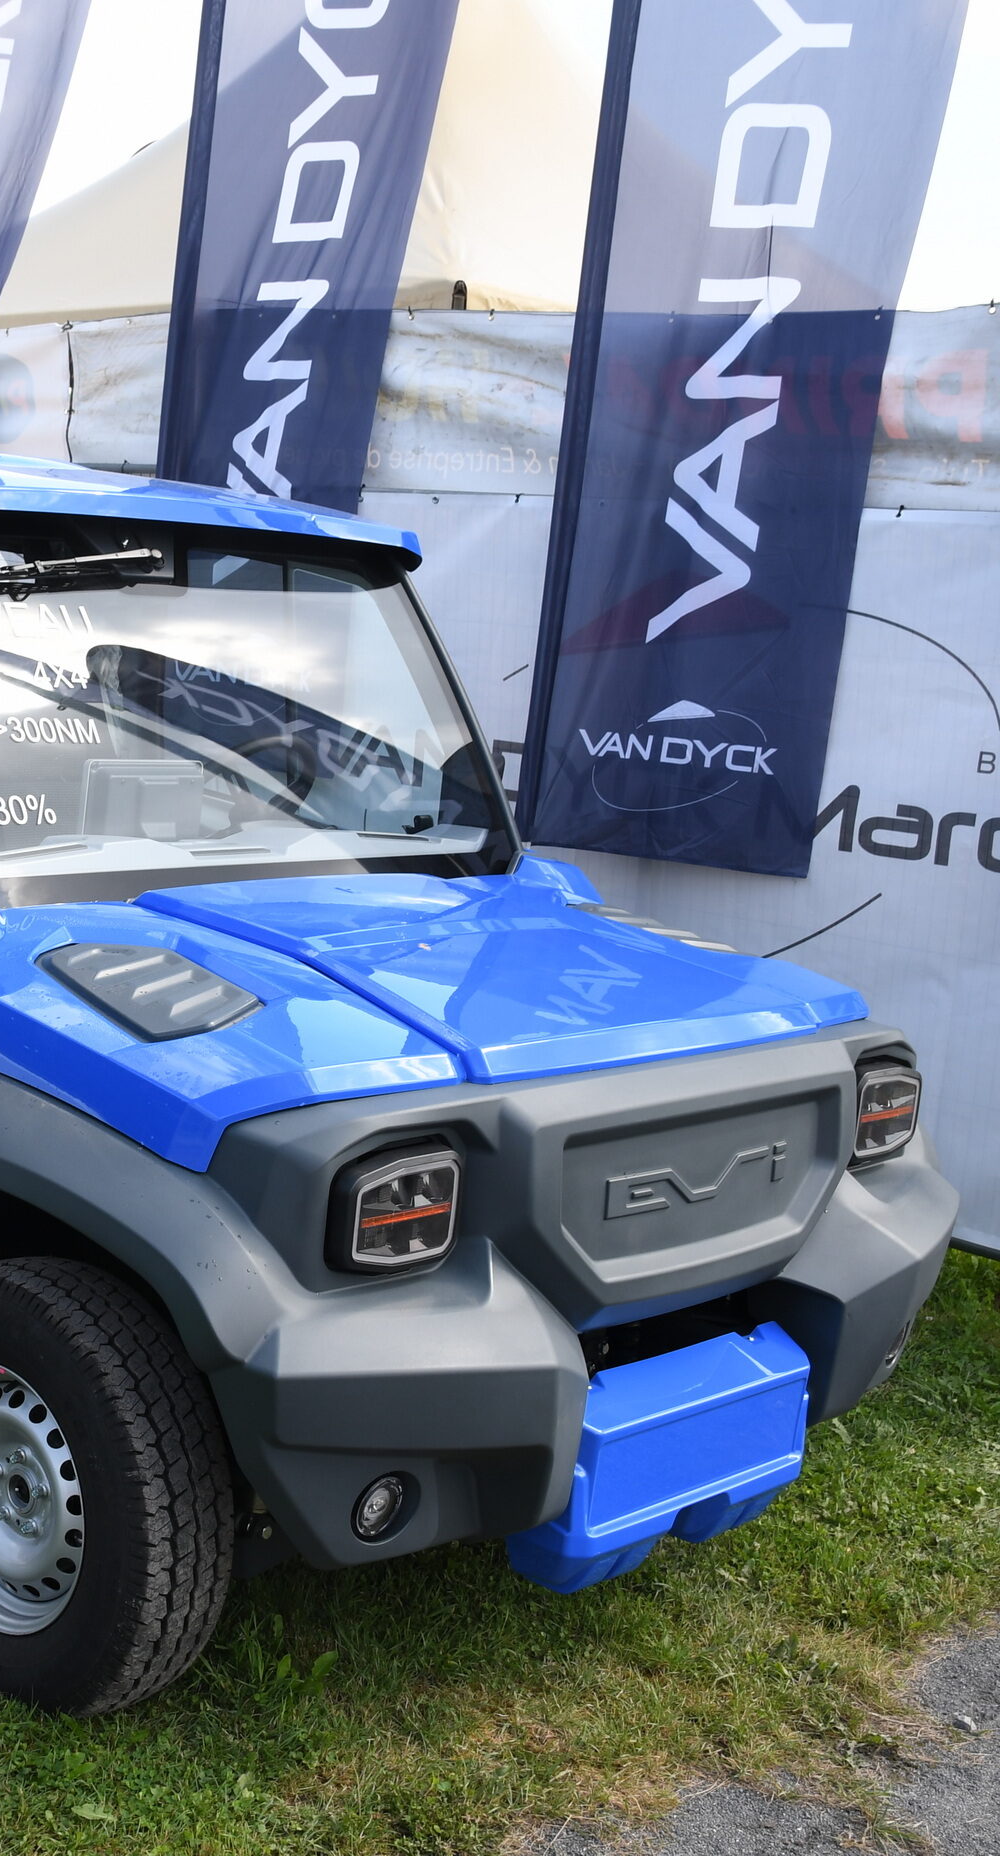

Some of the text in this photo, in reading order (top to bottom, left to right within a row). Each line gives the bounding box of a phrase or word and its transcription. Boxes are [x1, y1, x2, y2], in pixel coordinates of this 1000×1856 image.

[226, 278, 330, 500] AN
[645, 276, 801, 643] VAN
[33, 660, 92, 690] 4X4
[578, 728, 778, 776] VAN DYCK
